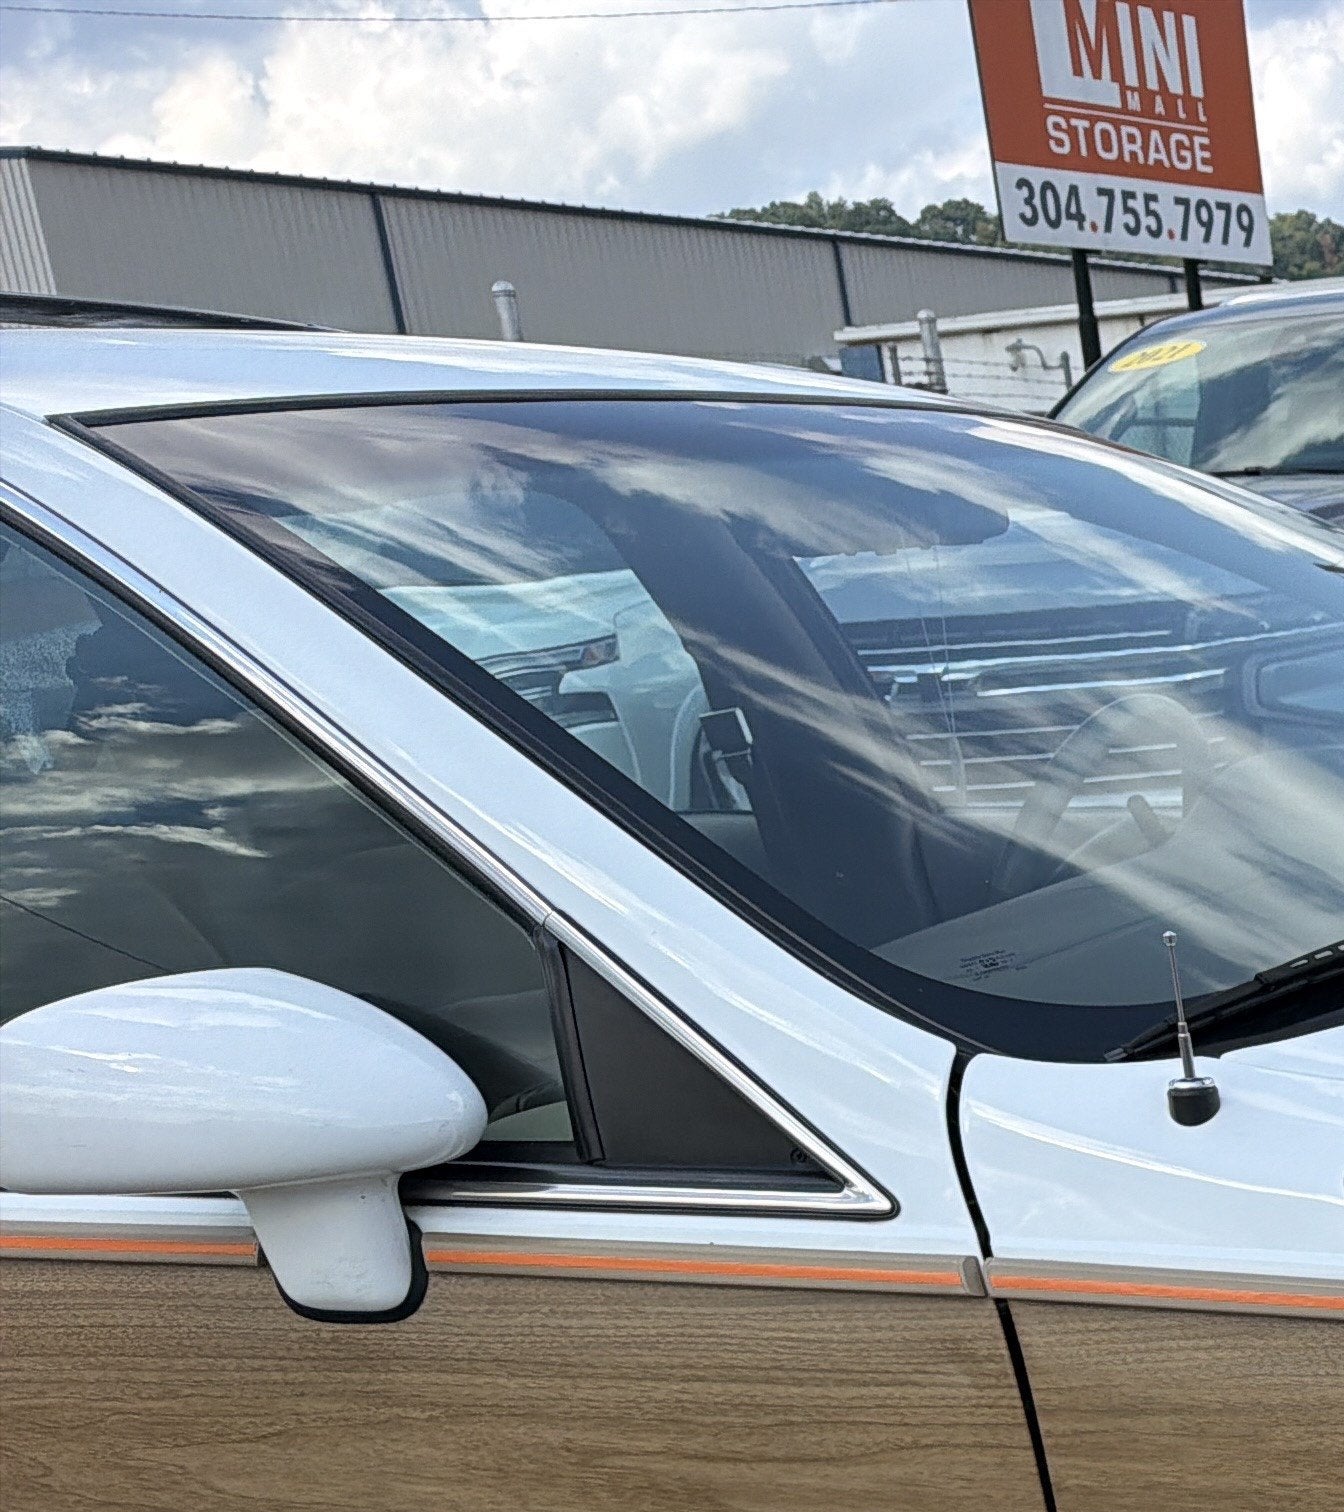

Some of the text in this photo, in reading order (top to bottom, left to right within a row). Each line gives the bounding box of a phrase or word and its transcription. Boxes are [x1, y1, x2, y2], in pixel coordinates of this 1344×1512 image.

[1125, 89, 1208, 123] MALL
[1046, 114, 1214, 174] STORAGE
[1014, 176, 1255, 248] 304.755.7979
